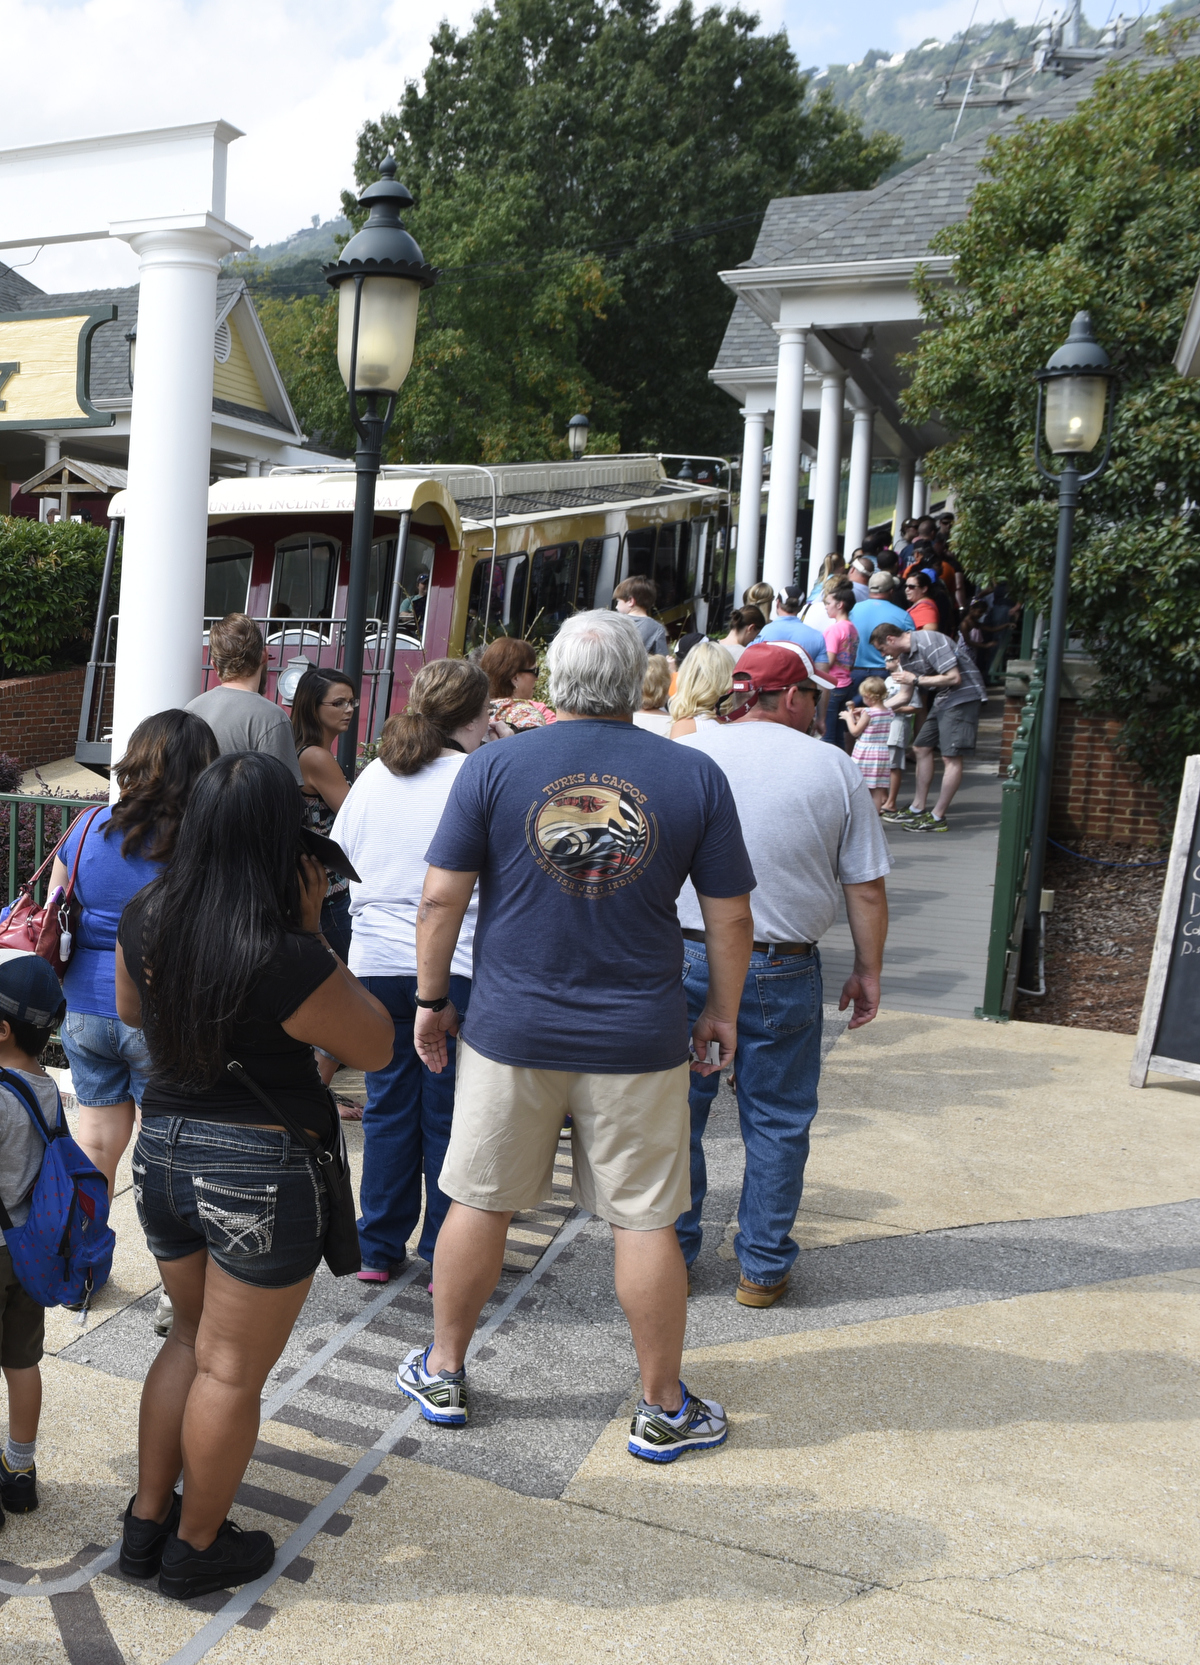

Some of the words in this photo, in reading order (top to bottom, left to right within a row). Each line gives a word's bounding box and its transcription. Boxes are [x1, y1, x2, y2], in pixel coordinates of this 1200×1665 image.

[542, 773, 586, 796] TURKS
[589, 773, 599, 783] &
[601, 774, 648, 804] CAICOS
[535, 857, 575, 890] BRITISH
[578, 884, 604, 894] WEST
[608, 868, 644, 890] INDIES
